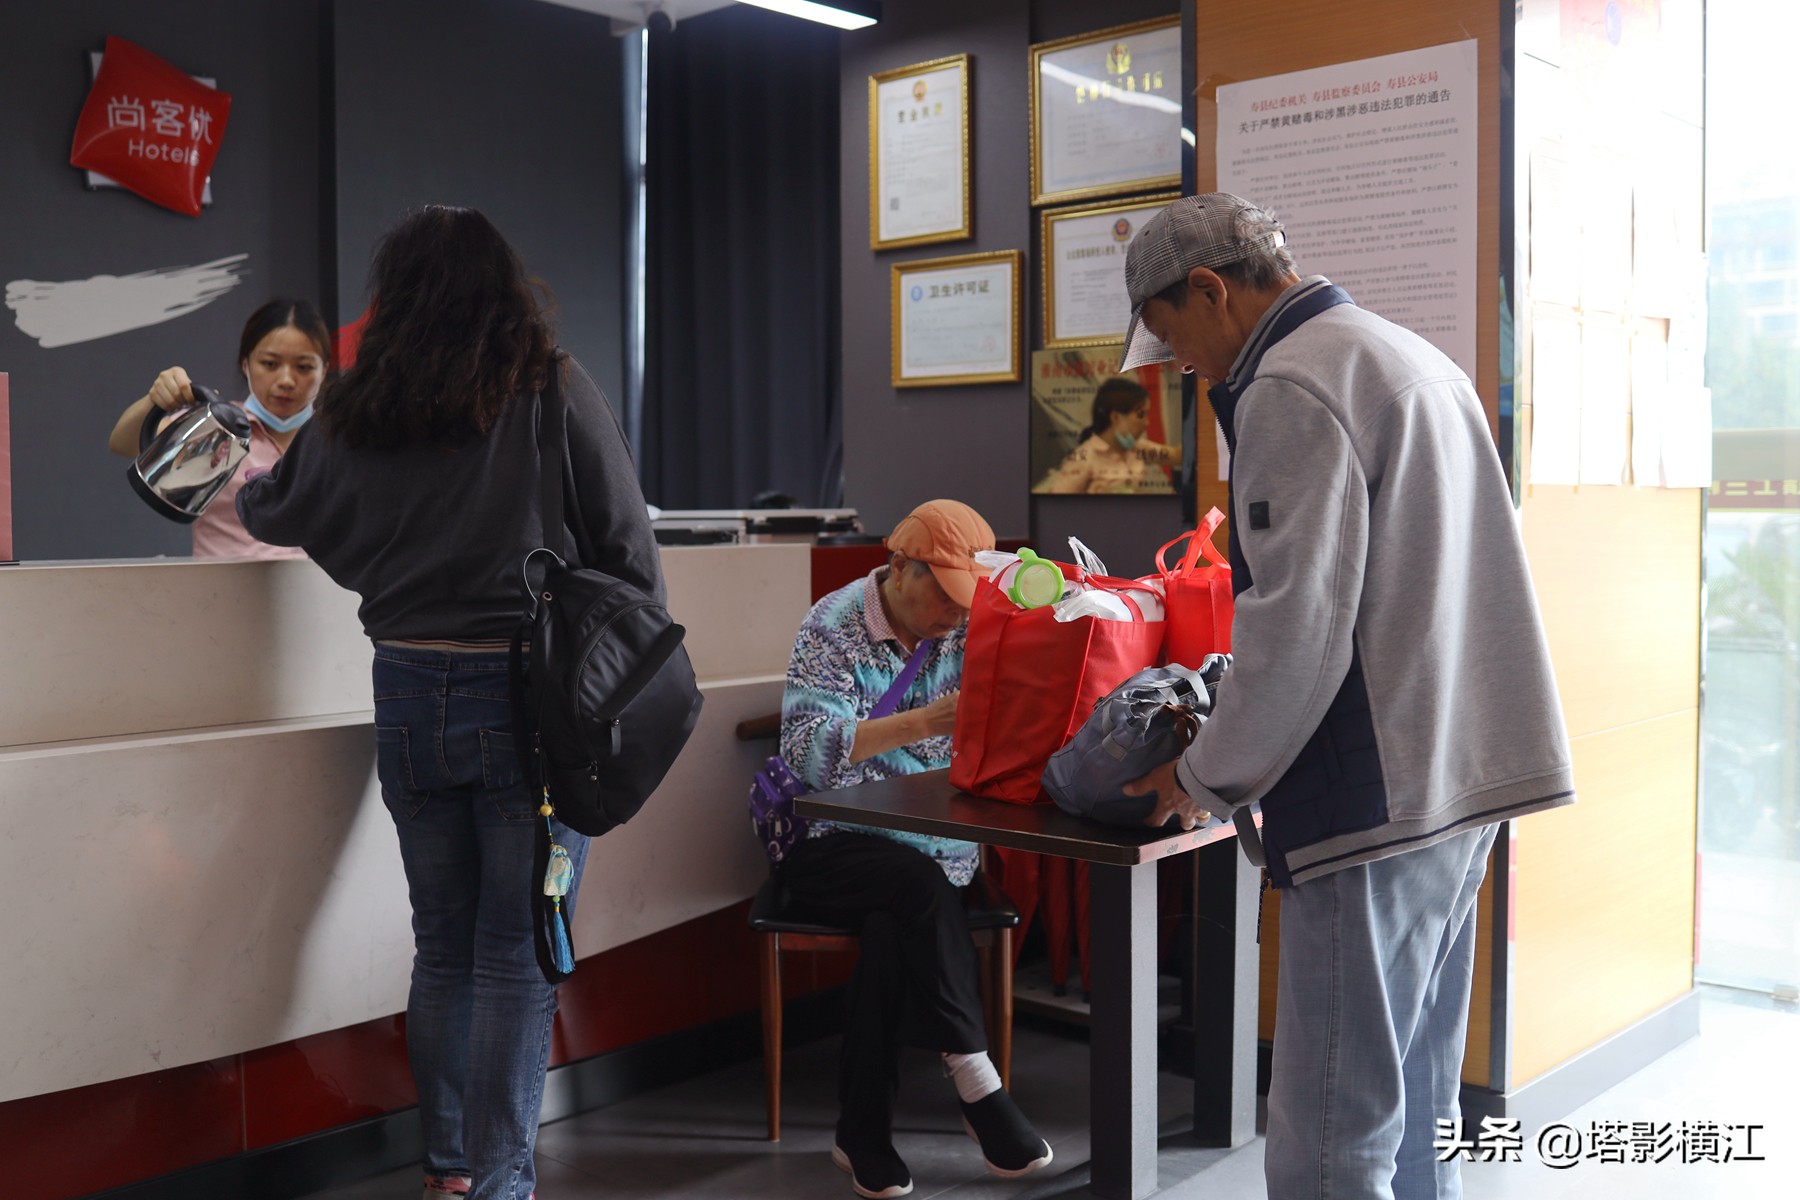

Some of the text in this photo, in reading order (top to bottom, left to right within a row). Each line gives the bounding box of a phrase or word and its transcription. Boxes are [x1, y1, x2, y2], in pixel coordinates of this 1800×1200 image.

[107, 95, 213, 145] 尚客优
[1238, 88, 1452, 134] 关于严禁黄赌毒和涉黑涉恶违法犯罪的通告
[127, 138, 200, 166] Hotels
[928, 279, 990, 299] 卫生许可证
